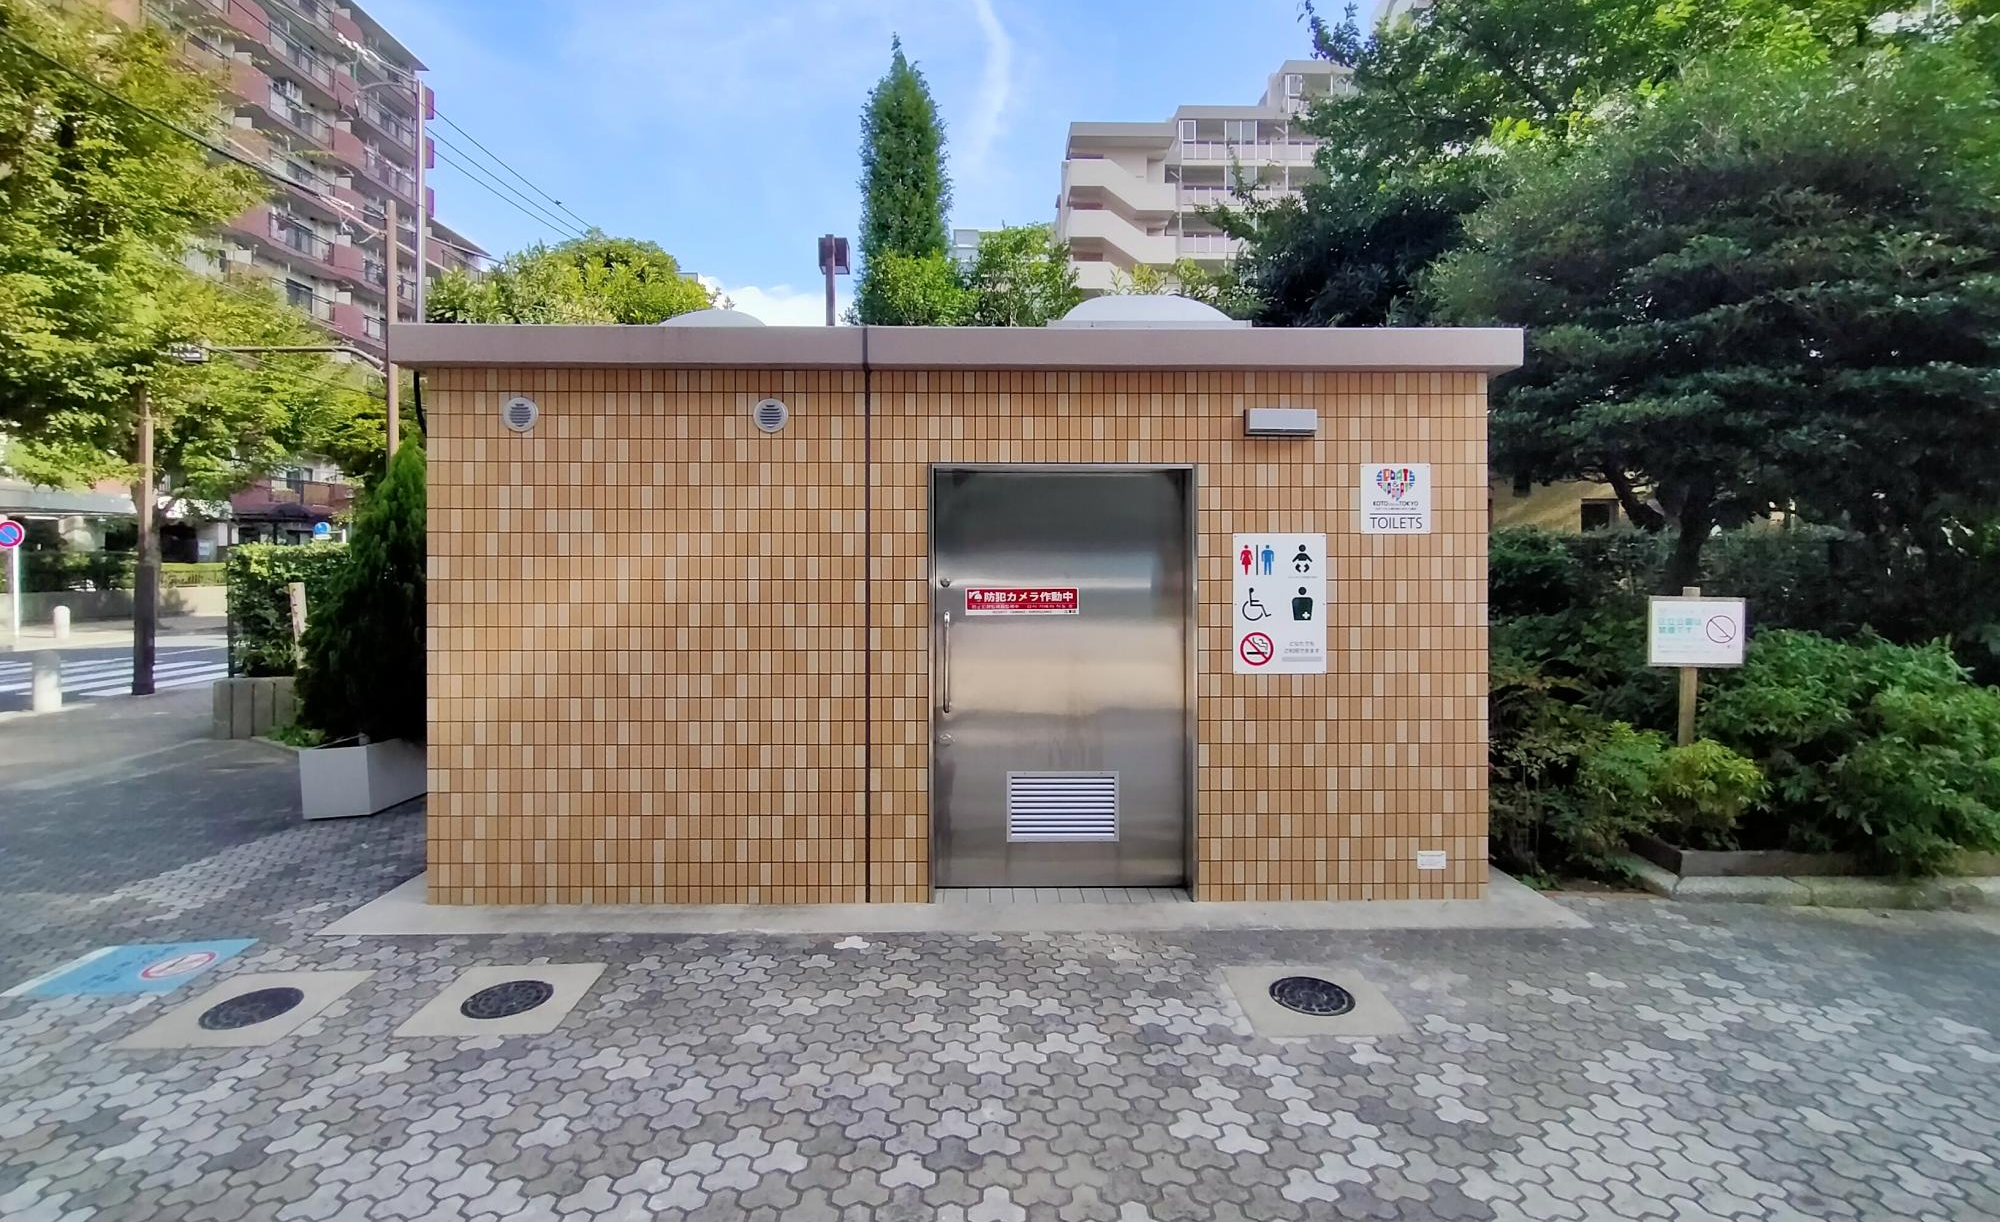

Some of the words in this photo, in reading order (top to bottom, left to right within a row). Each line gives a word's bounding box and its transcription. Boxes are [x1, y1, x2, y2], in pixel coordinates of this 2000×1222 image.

[1376, 468, 1416, 482] SPORTS
[1369, 517, 1422, 529] TOILETS
[984, 591, 1074, 603] 防犯カメラ作動中
